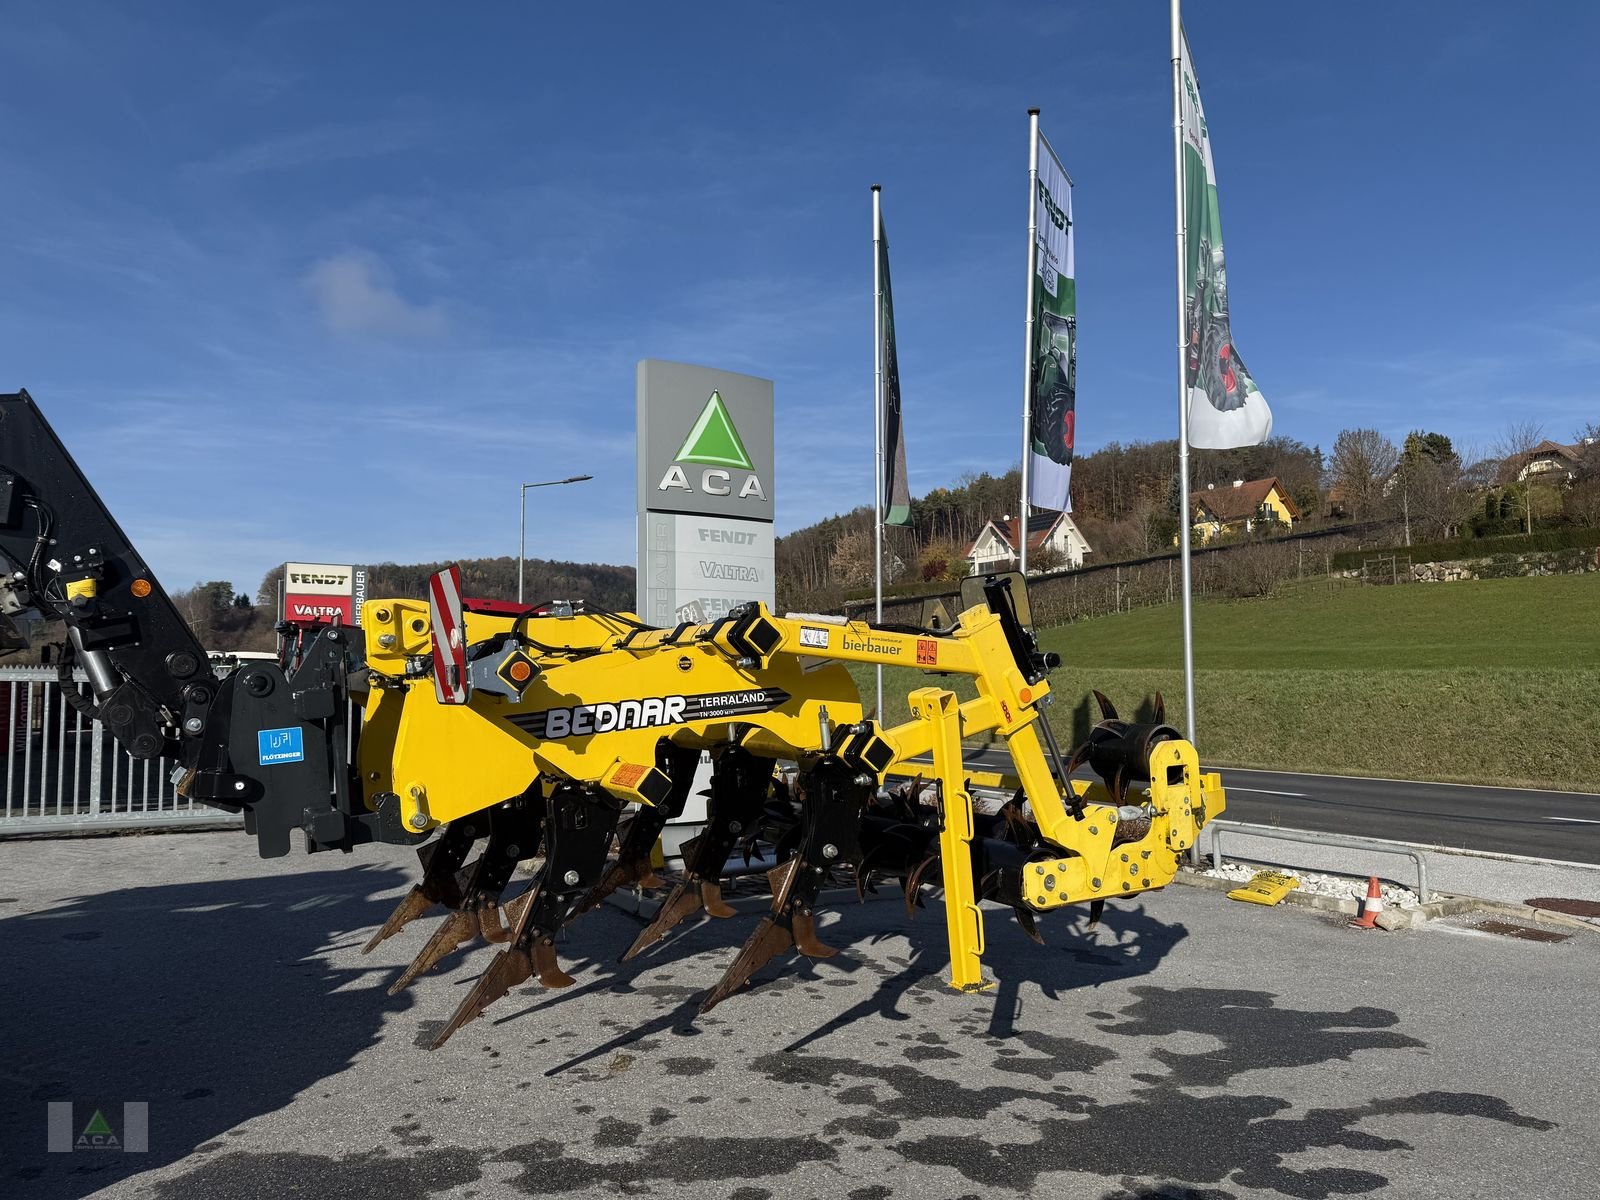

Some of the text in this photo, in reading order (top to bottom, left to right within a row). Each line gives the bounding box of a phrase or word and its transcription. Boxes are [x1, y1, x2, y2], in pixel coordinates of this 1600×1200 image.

[1038, 178, 1072, 236] FENDT
[658, 465, 767, 501] ACA
[698, 528, 757, 545] FENDT
[290, 573, 348, 585] FENDT
[699, 561, 759, 582] VALTRA
[294, 604, 343, 617] VALTRA
[842, 634, 902, 655] bierbauer
[698, 692, 765, 708] TERRALAND
[546, 697, 686, 738] BEDNAR
[709, 709, 724, 717] 3000
